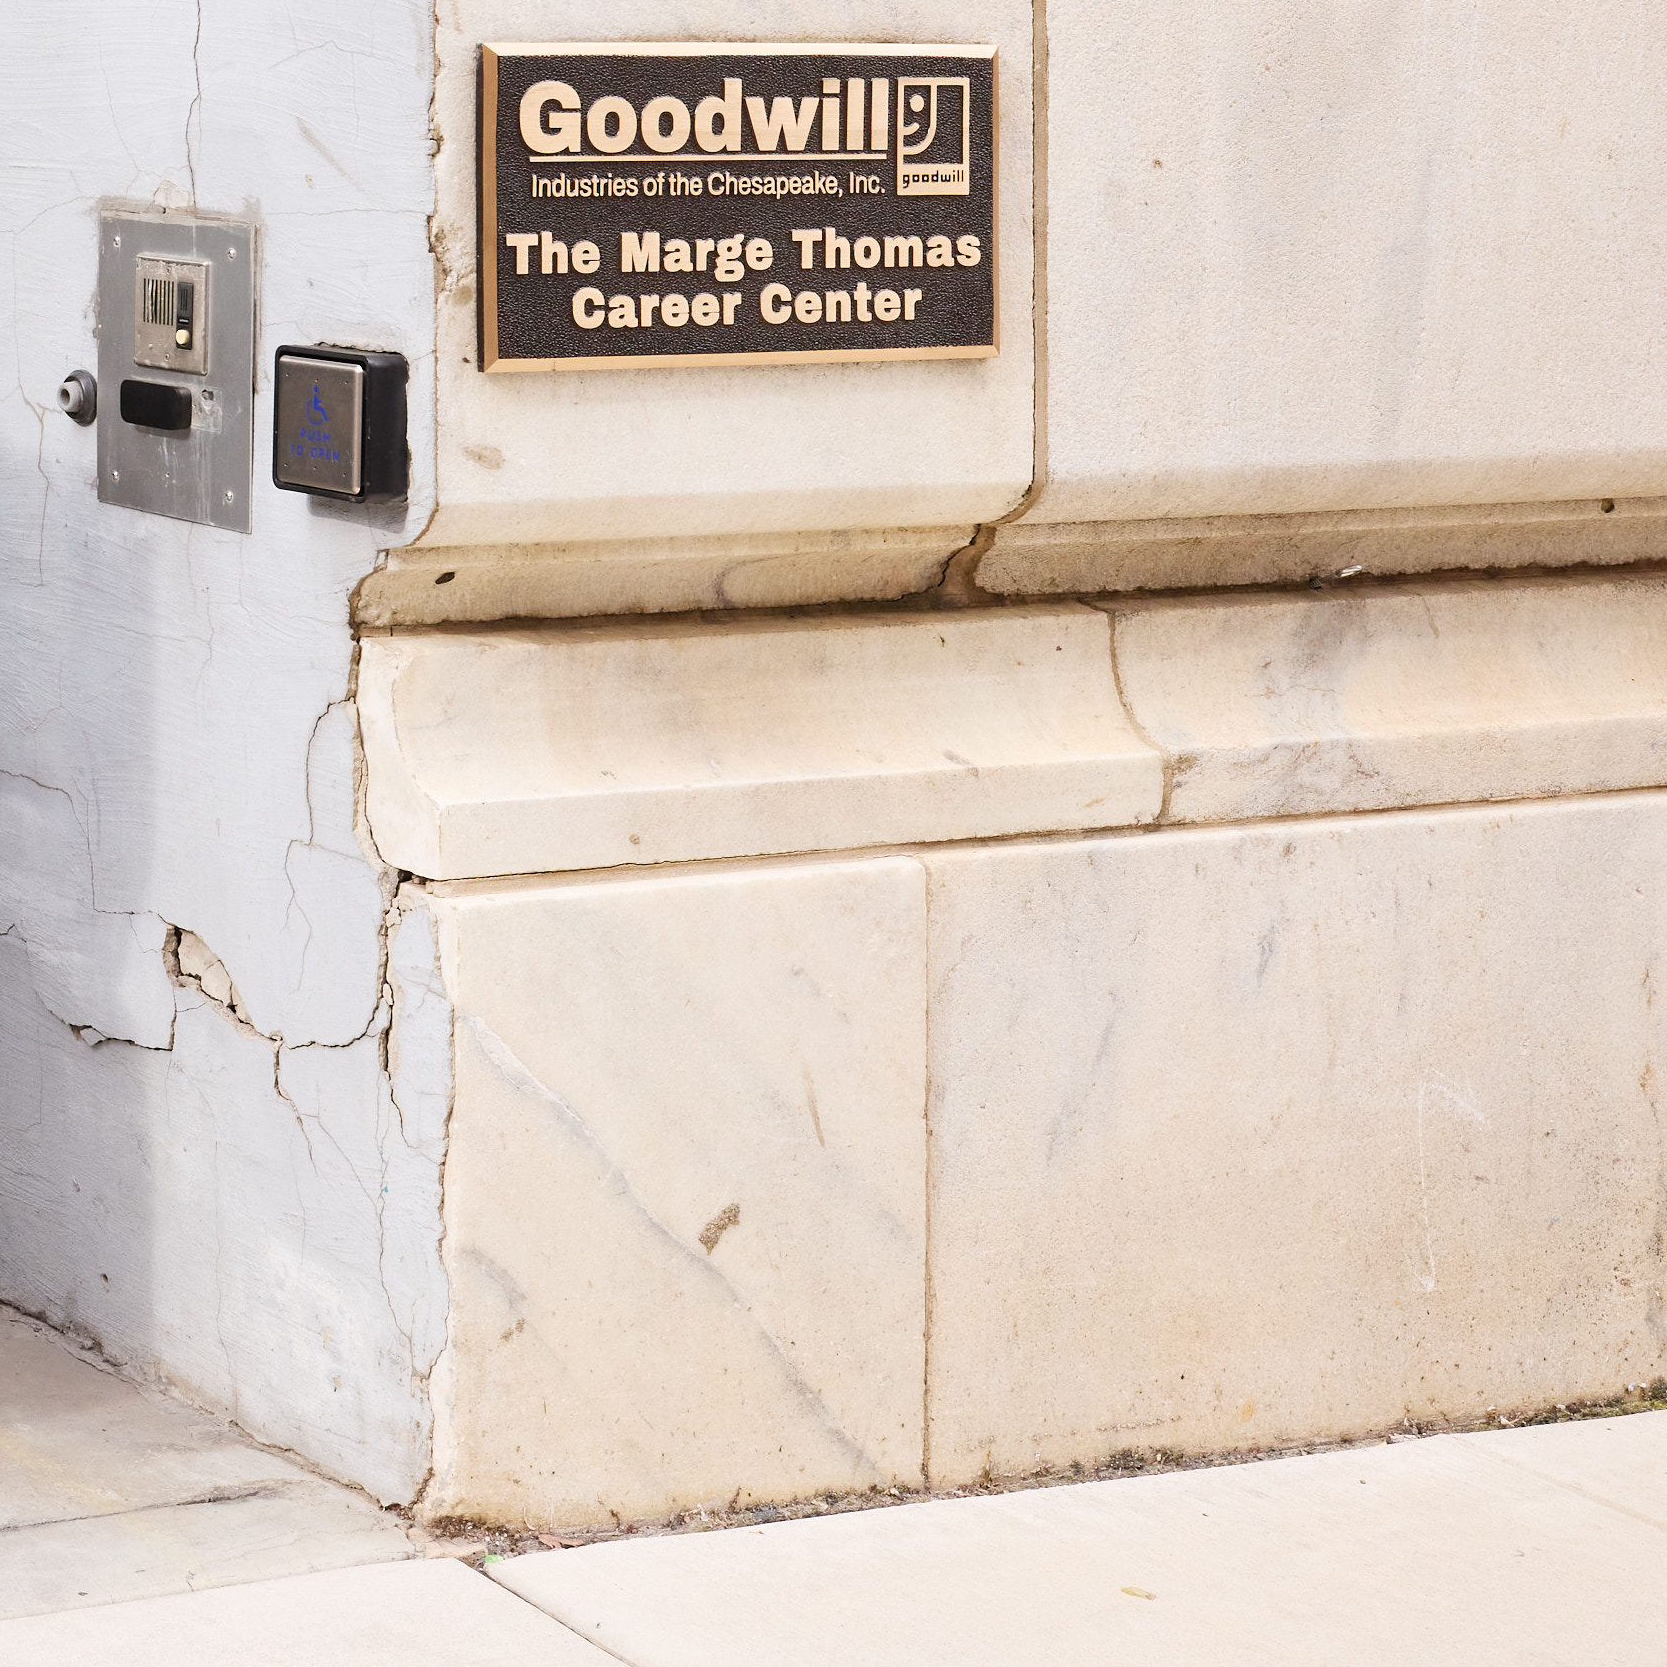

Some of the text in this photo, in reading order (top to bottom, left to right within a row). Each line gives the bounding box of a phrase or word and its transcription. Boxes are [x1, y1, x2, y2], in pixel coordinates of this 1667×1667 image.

[518, 77, 890, 154] Goodwill
[531, 170, 886, 200] Industries of the Chesapeake, Inc.
[901, 170, 965, 189] goodwill
[505, 227, 982, 283] The Marge Thomas
[571, 282, 923, 330] Career Center
[300, 427, 331, 443] PUSH
[290, 443, 340, 461] TO OPEN
